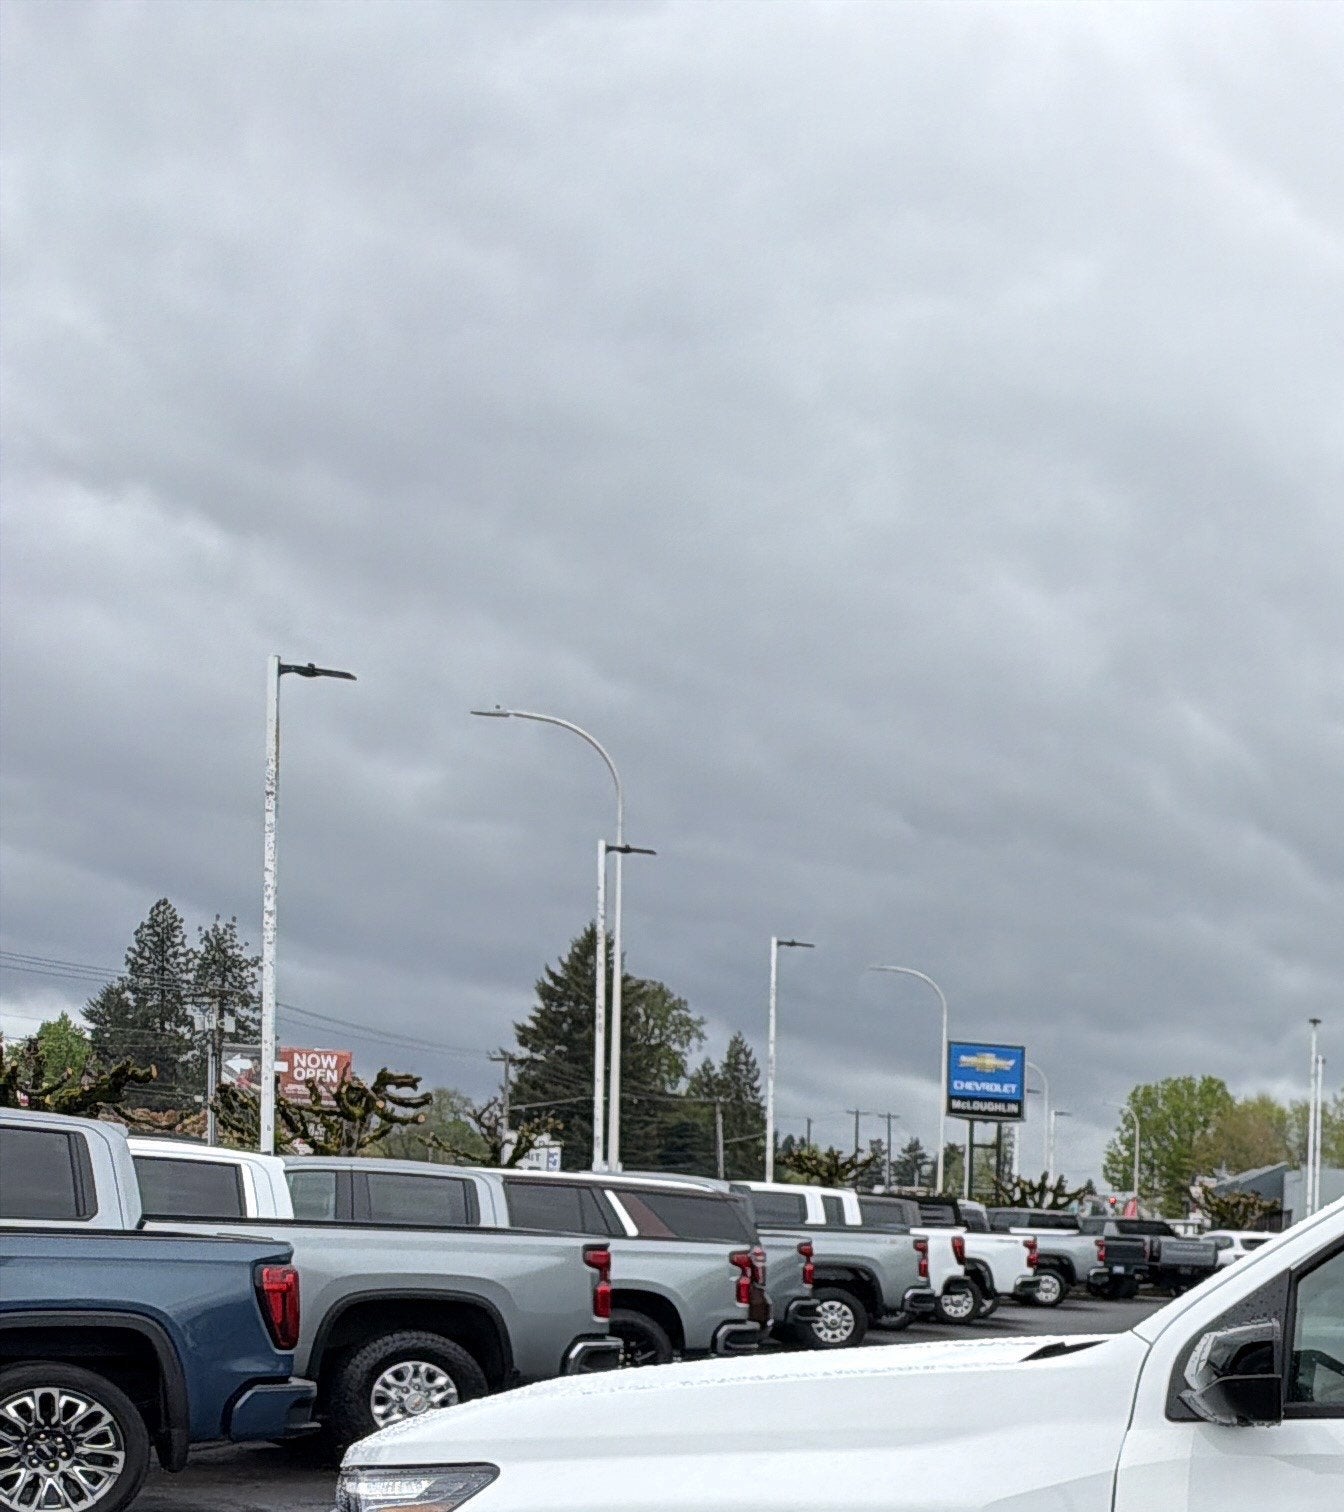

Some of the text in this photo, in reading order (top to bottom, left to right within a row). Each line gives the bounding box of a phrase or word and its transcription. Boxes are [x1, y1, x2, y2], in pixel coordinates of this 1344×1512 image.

[293, 1053, 338, 1069] NOW
[293, 1067, 338, 1083] OPEN
[953, 1080, 1017, 1094] CHEVROLET
